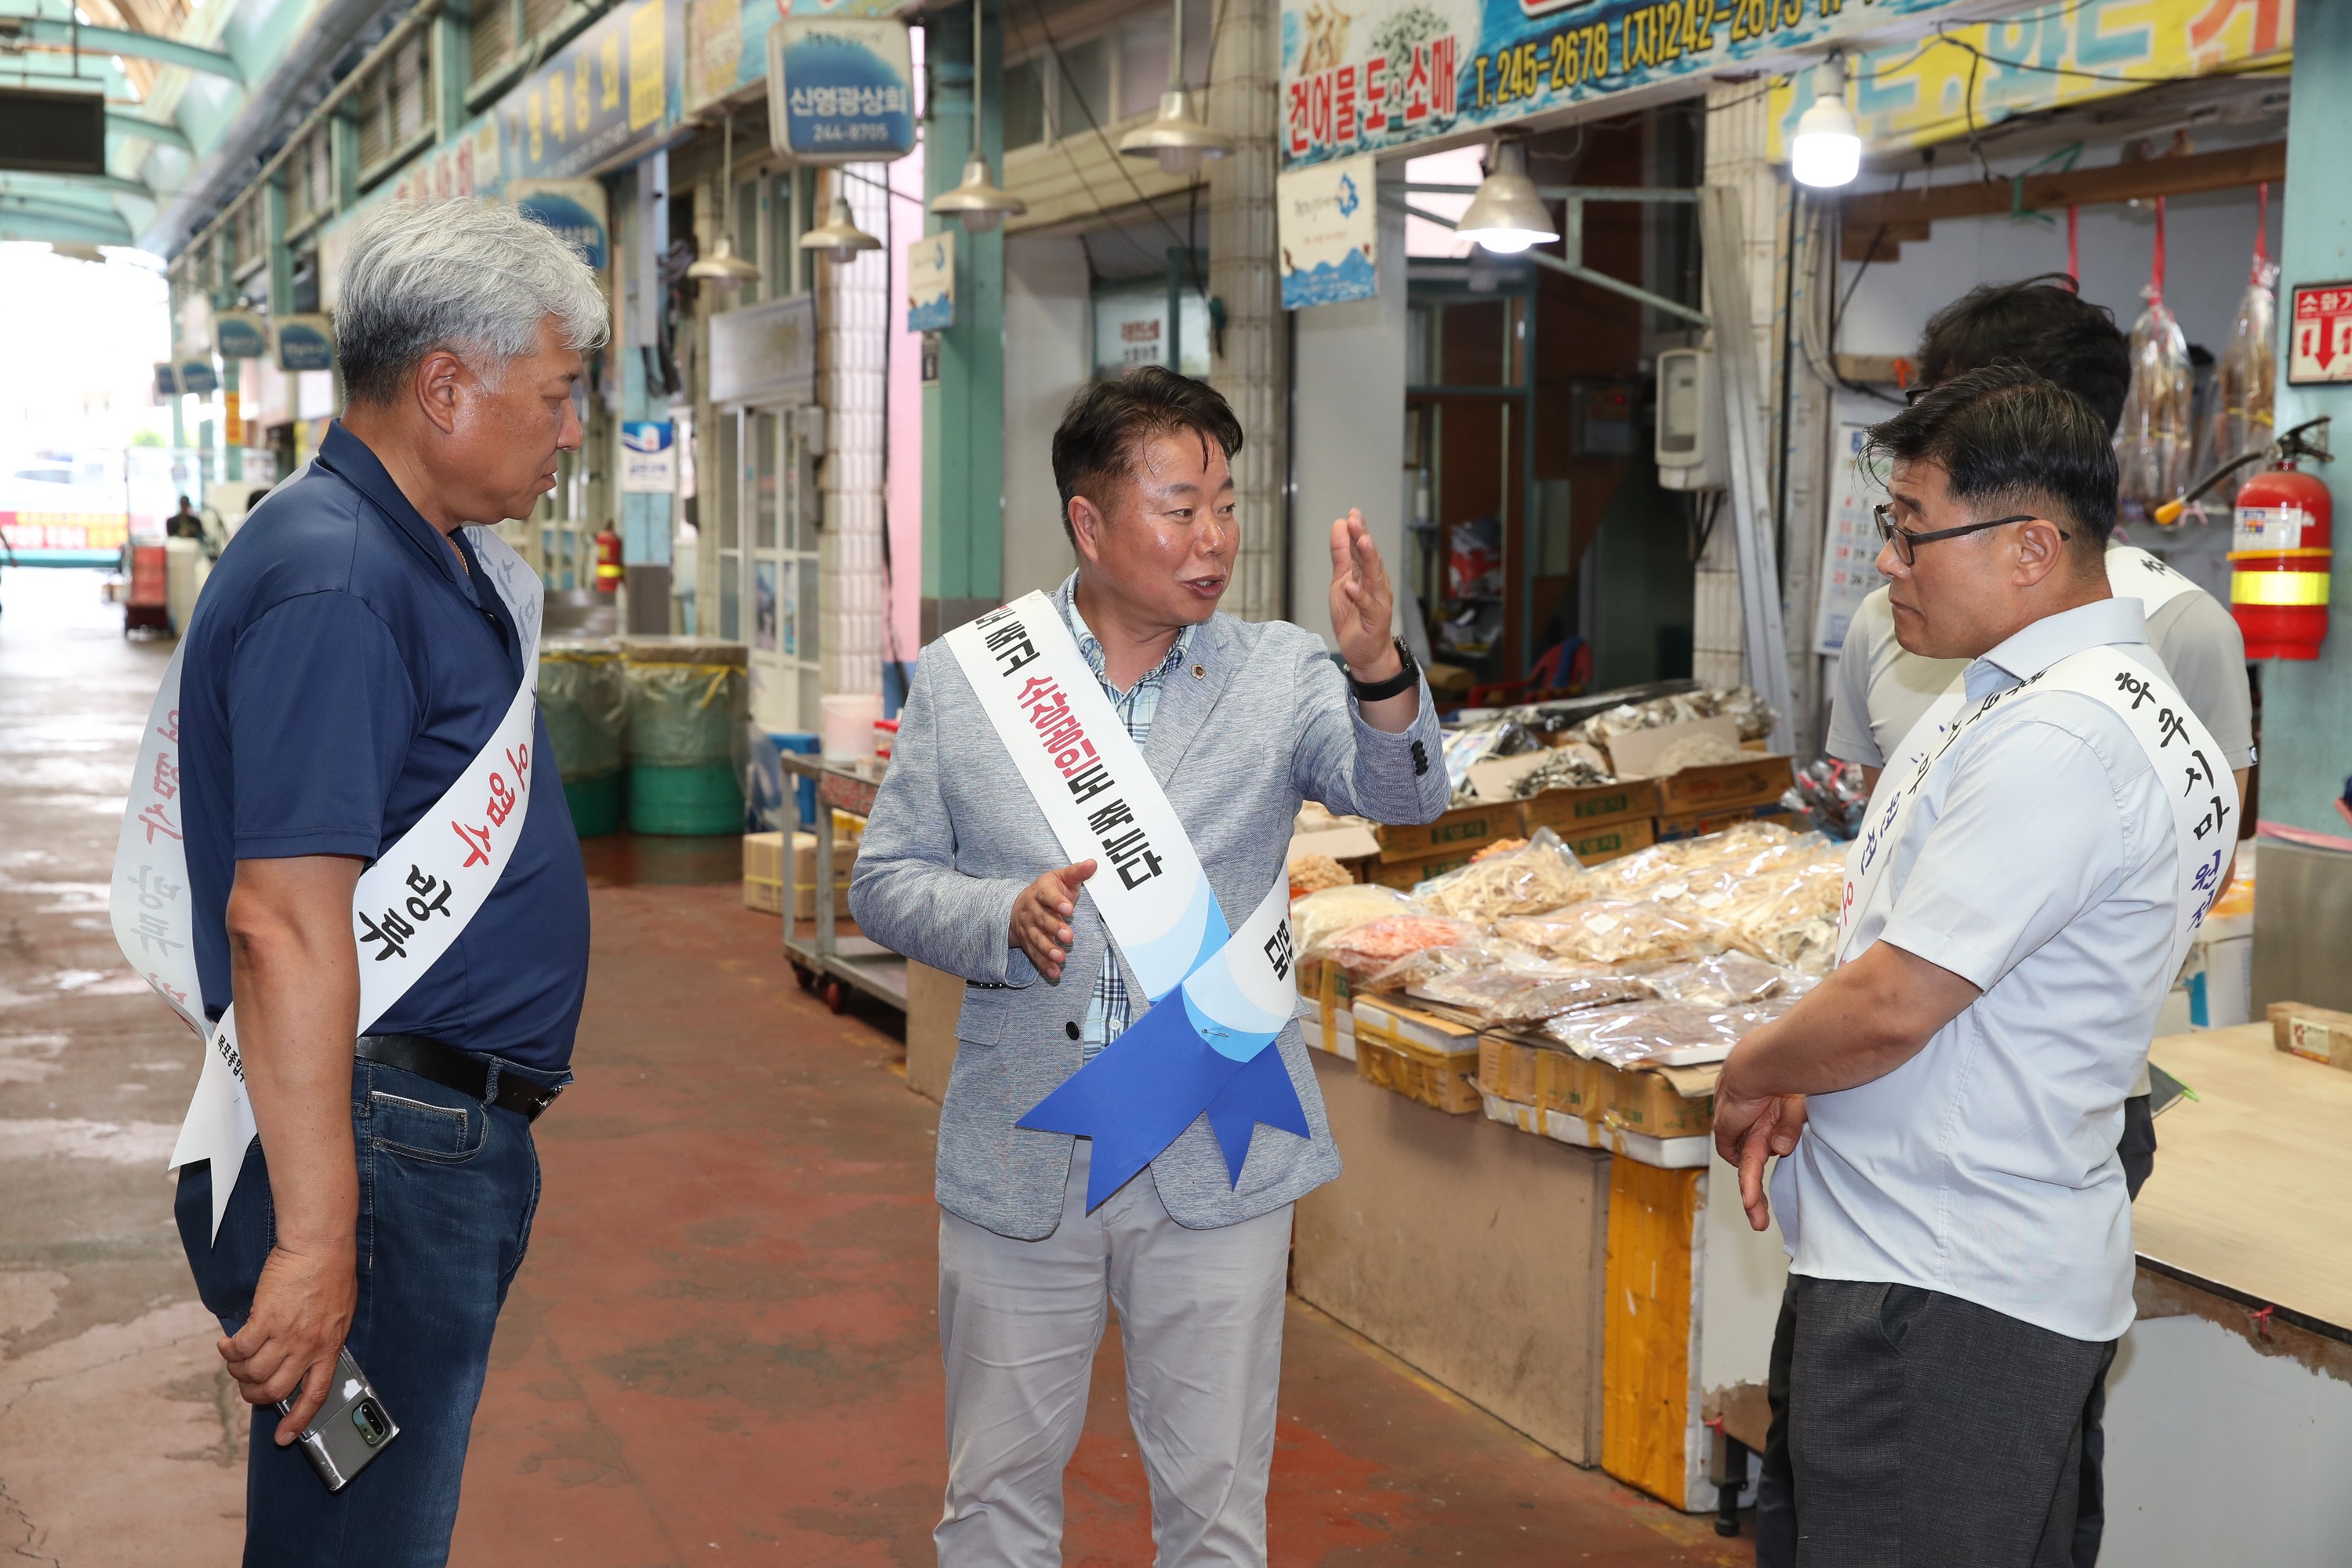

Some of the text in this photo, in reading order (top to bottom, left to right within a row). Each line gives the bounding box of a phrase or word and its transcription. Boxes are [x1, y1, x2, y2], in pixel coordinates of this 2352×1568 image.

[790, 85, 907, 116] 신영광상회
[1290, 65, 1355, 153] 건어물
[358, 742, 528, 961] 오염수 방류
[985, 621, 1040, 677] 죽고
[1017, 676, 1115, 804] 소상공인도
[1087, 798, 1162, 891] 죽는다
[2115, 672, 2230, 841] 후쿠시마
[2186, 849, 2222, 933] 원전
